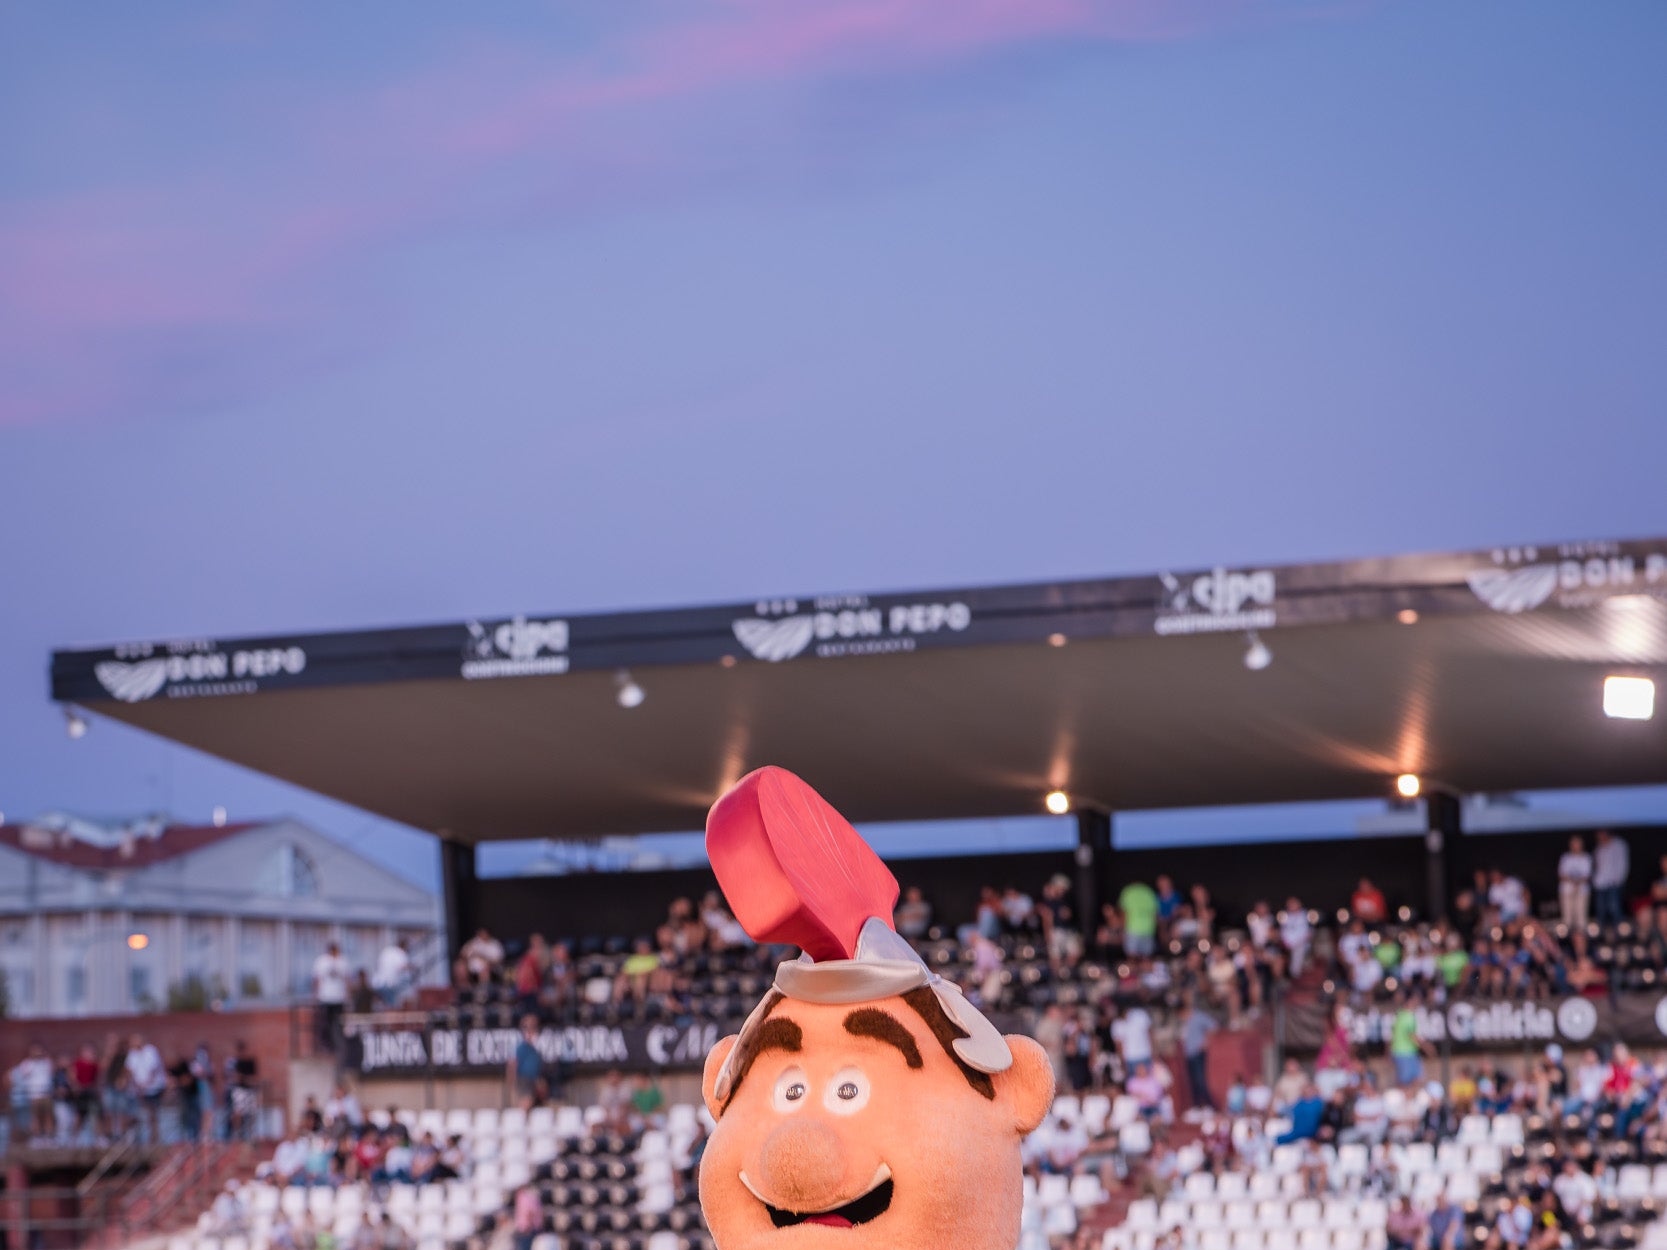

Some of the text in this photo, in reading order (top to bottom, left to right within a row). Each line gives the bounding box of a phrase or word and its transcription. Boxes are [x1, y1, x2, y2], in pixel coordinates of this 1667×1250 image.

[814, 602, 970, 639] DON PEPO
[167, 652, 228, 681] DON
[232, 646, 306, 677] PEPO
[431, 1030, 462, 1065] DE
